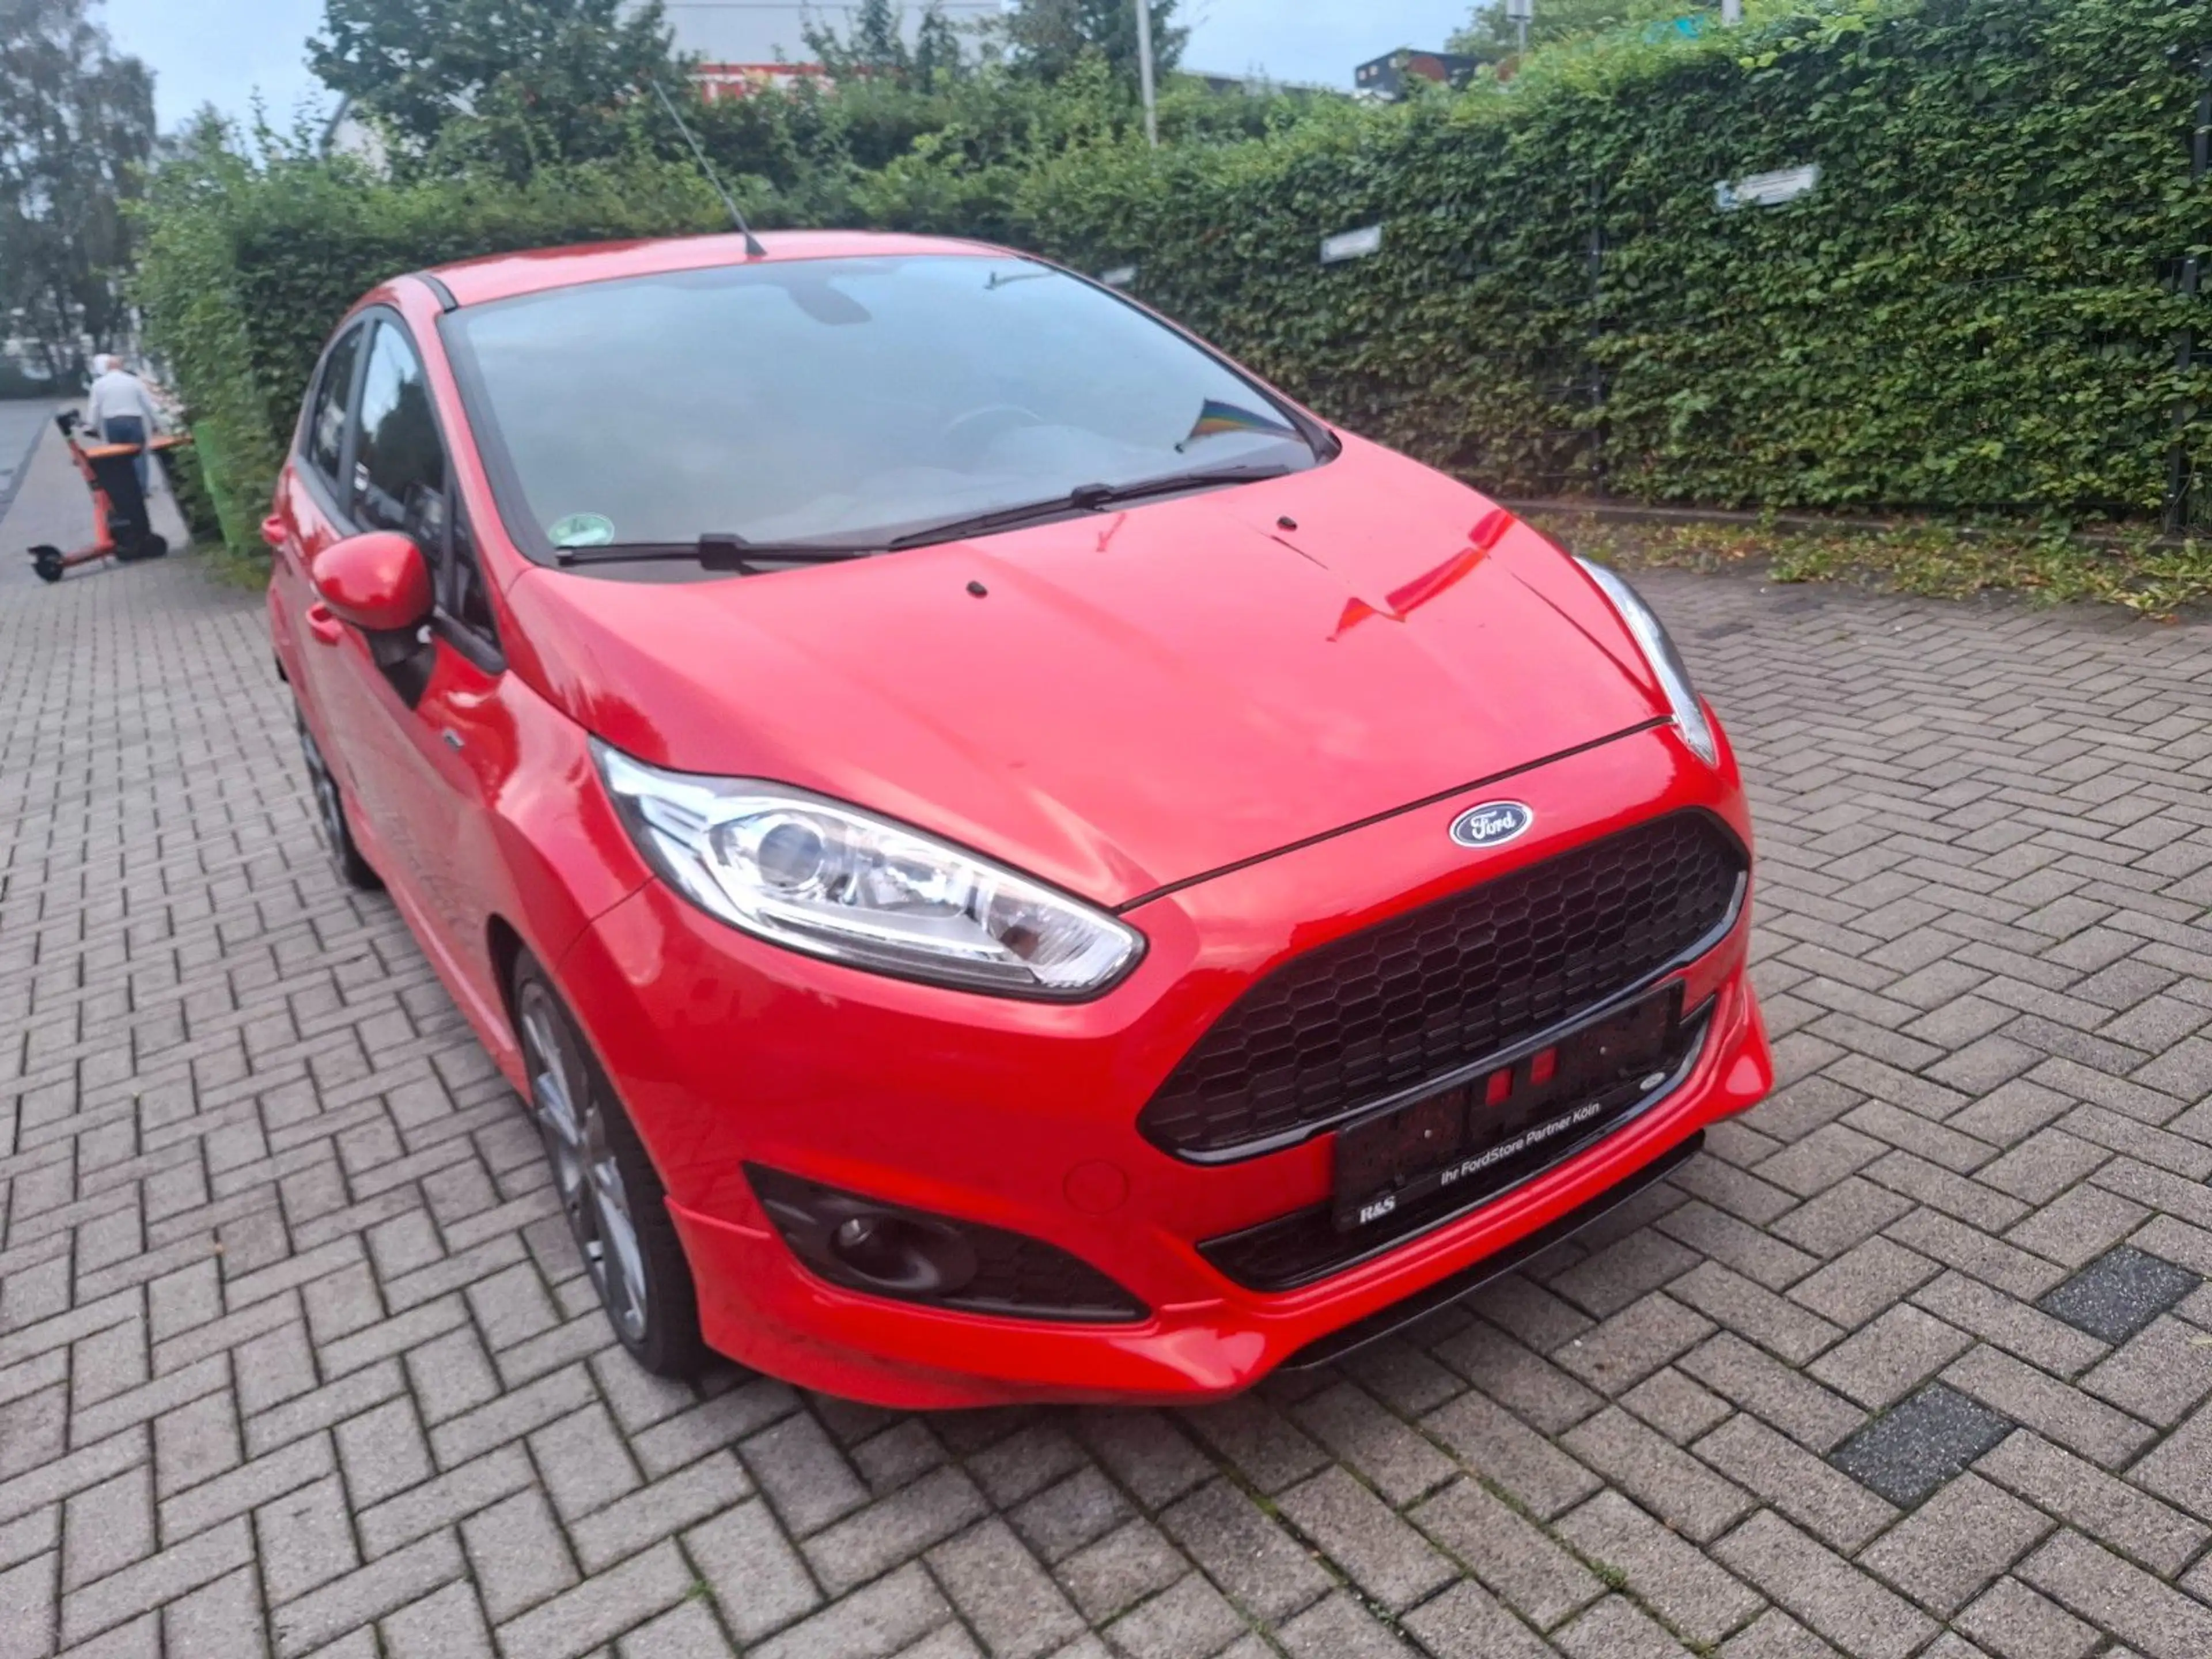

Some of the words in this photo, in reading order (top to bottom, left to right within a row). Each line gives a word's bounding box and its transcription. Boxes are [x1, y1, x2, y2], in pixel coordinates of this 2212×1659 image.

[1471, 810, 1516, 840] Ford
[1441, 1168, 1459, 1186] Ihr
[1461, 1138, 1524, 1176] FordStore
[1526, 1116, 1572, 1145] Partner
[1573, 1102, 1601, 1123] Köln
